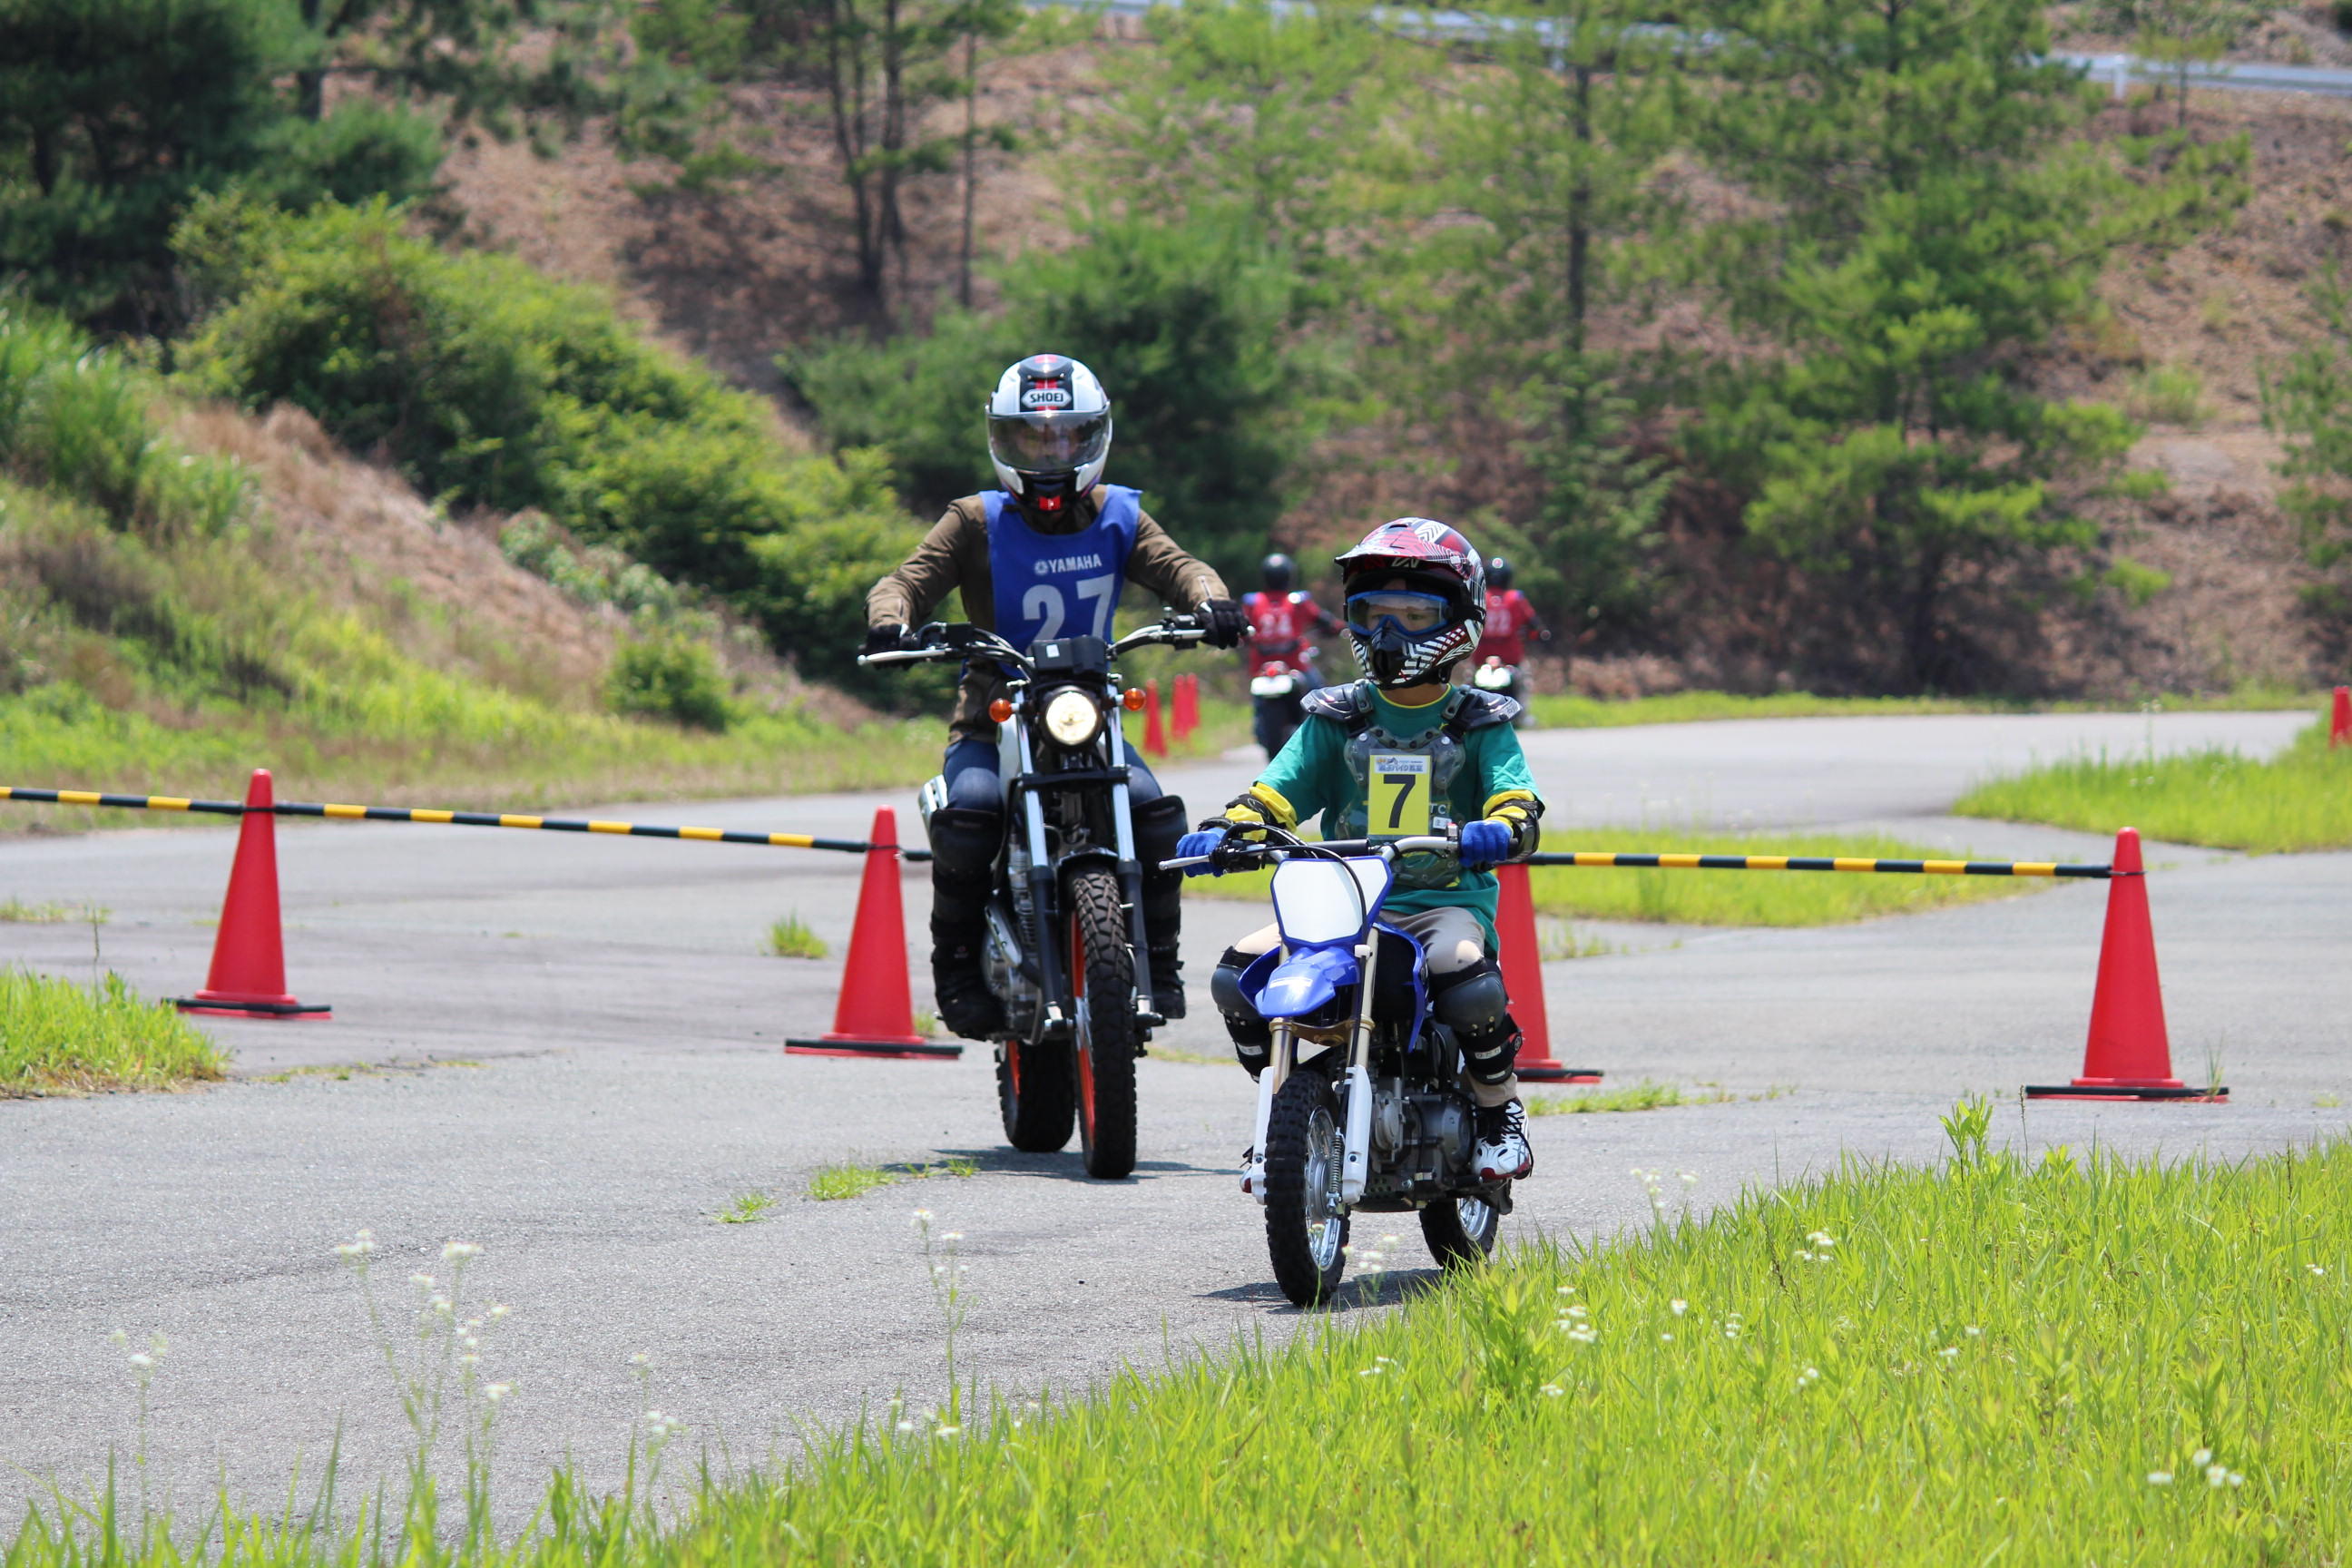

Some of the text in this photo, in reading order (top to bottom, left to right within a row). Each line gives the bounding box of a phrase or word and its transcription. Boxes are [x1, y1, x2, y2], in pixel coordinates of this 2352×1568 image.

[1030, 392, 1064, 403] SHOEI
[1048, 553, 1102, 573] YAMAHA
[1022, 573, 1115, 657] 27
[1383, 774, 1416, 828] 7
